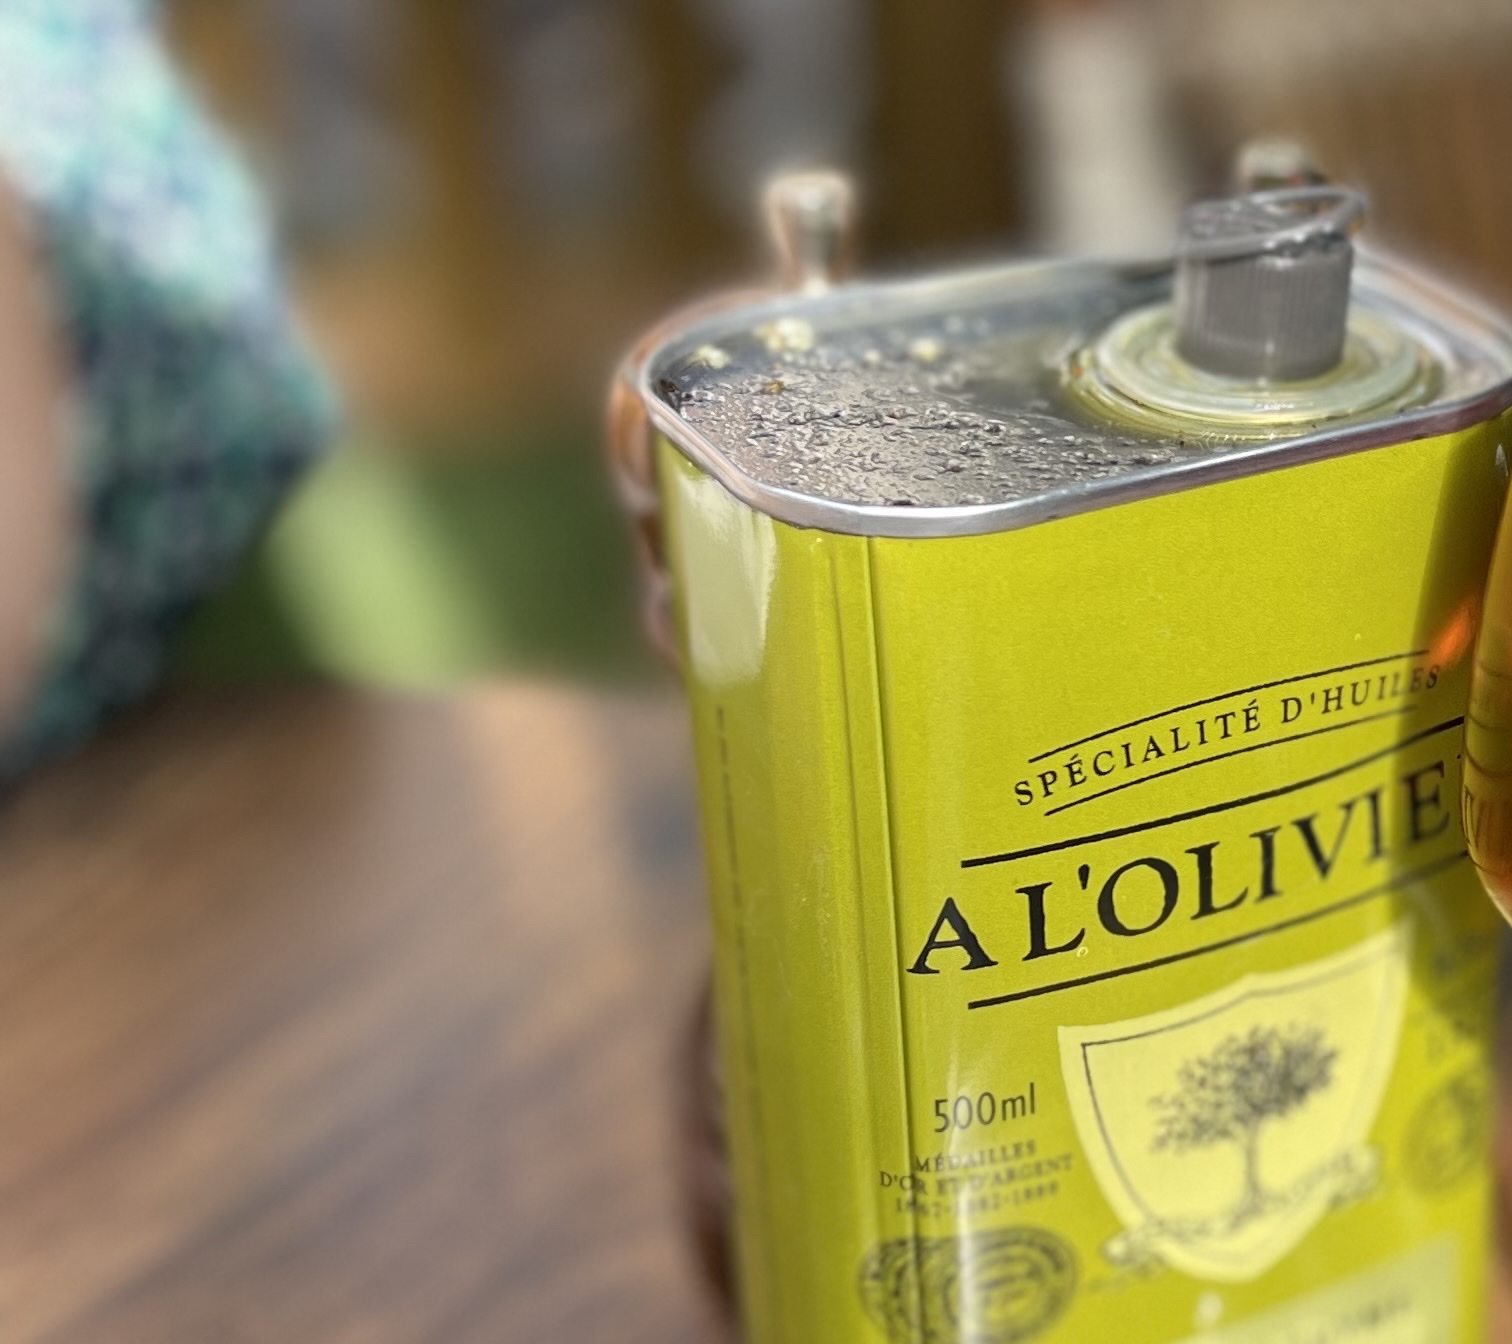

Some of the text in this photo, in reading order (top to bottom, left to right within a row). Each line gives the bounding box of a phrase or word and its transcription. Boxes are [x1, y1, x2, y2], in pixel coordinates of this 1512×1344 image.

[1014, 663, 1441, 806] SPÉCIALITÉ D'HUILES
[905, 757, 1461, 975] A L'OLIVIE
[933, 1082, 1036, 1133] 500ml
